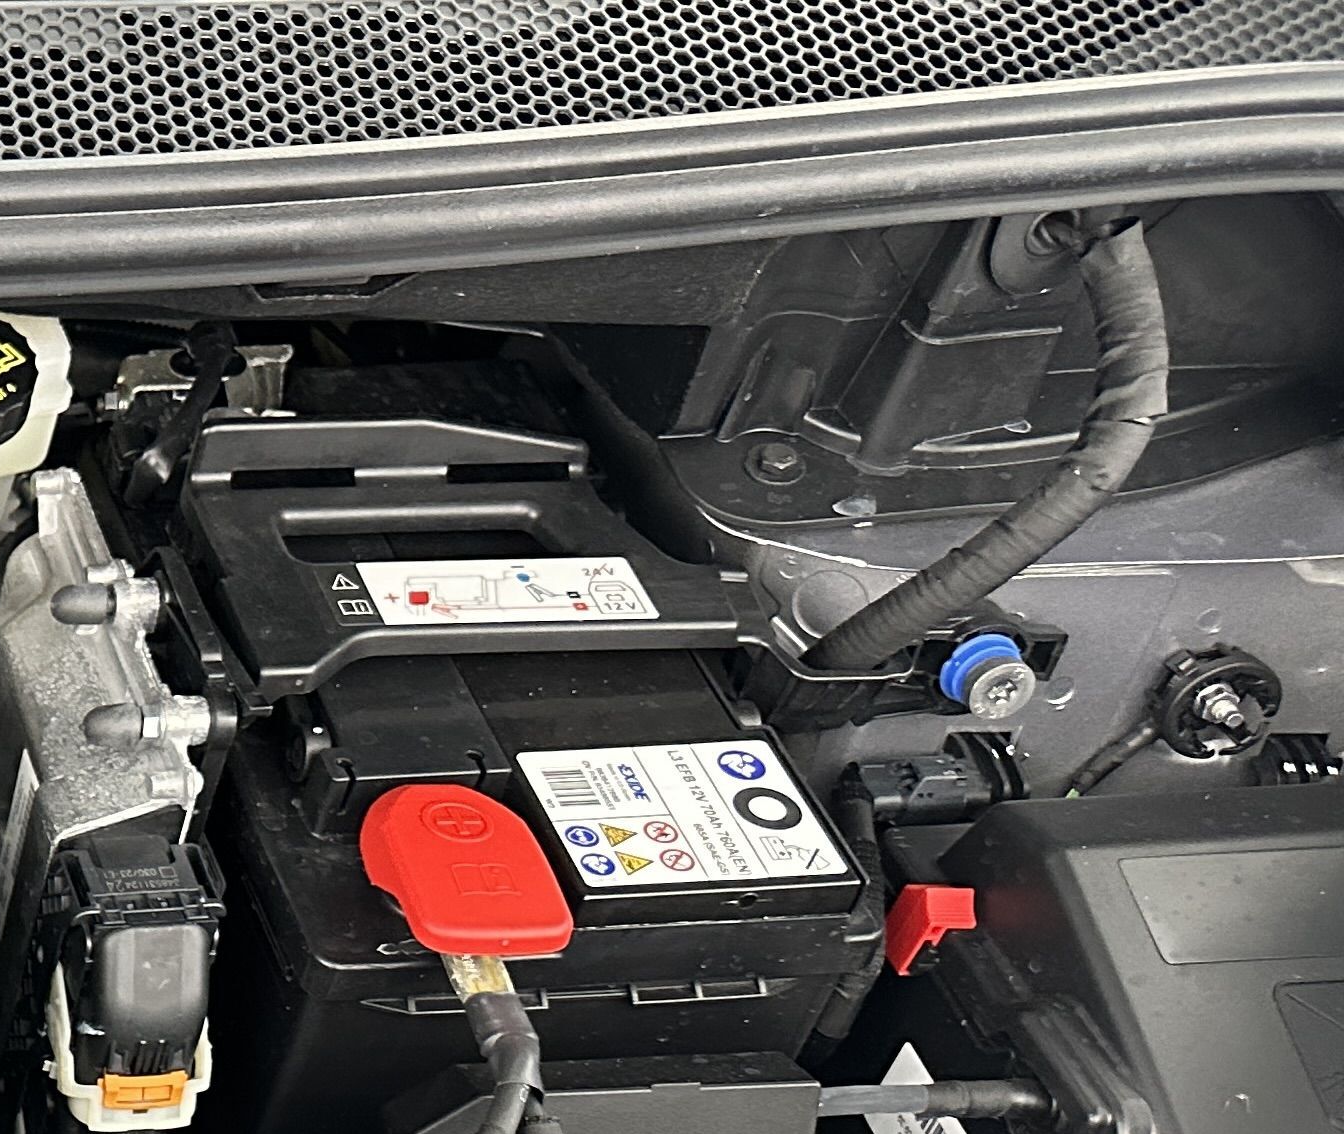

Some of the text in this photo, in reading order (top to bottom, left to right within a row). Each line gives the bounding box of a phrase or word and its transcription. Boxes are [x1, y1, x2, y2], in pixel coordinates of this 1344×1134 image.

[667, 750, 684, 762] L3
[616, 763, 652, 802] EXIDE
[674, 764, 698, 783] EFB
[689, 785, 709, 803] 12V
[699, 805, 725, 830] 70Ah
